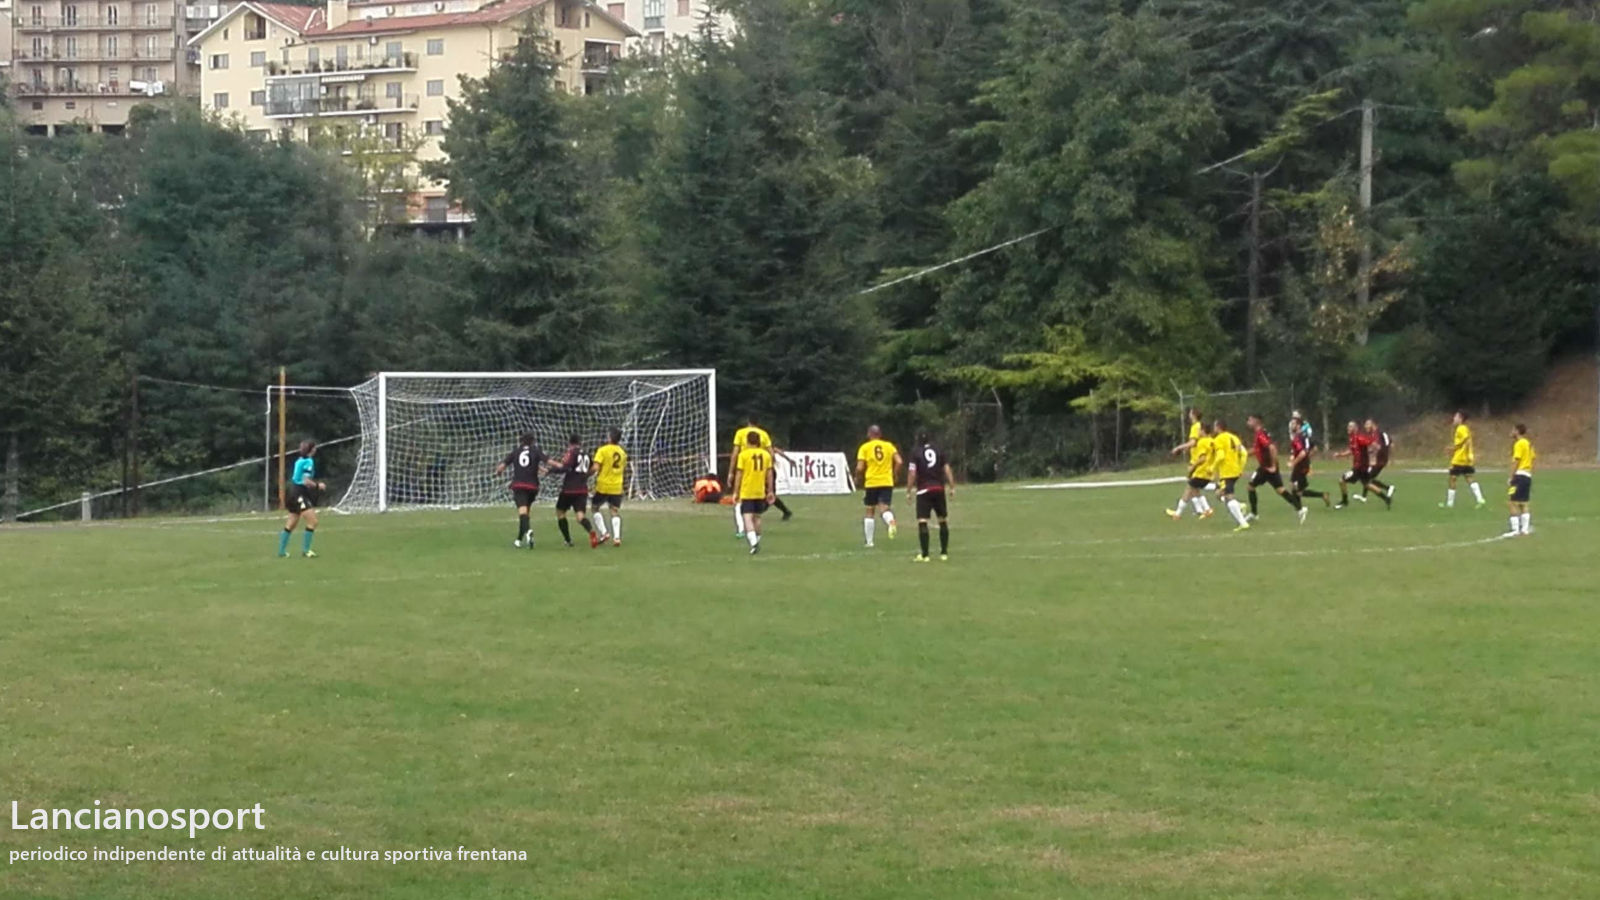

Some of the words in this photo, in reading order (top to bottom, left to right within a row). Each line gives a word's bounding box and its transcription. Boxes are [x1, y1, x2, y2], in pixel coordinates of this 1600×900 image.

[518, 450, 530, 467] 6
[612, 452, 621, 469] 2
[874, 445, 885, 462] 6
[924, 448, 937, 468] 9
[575, 454, 591, 473] 20
[752, 454, 763, 471] 11
